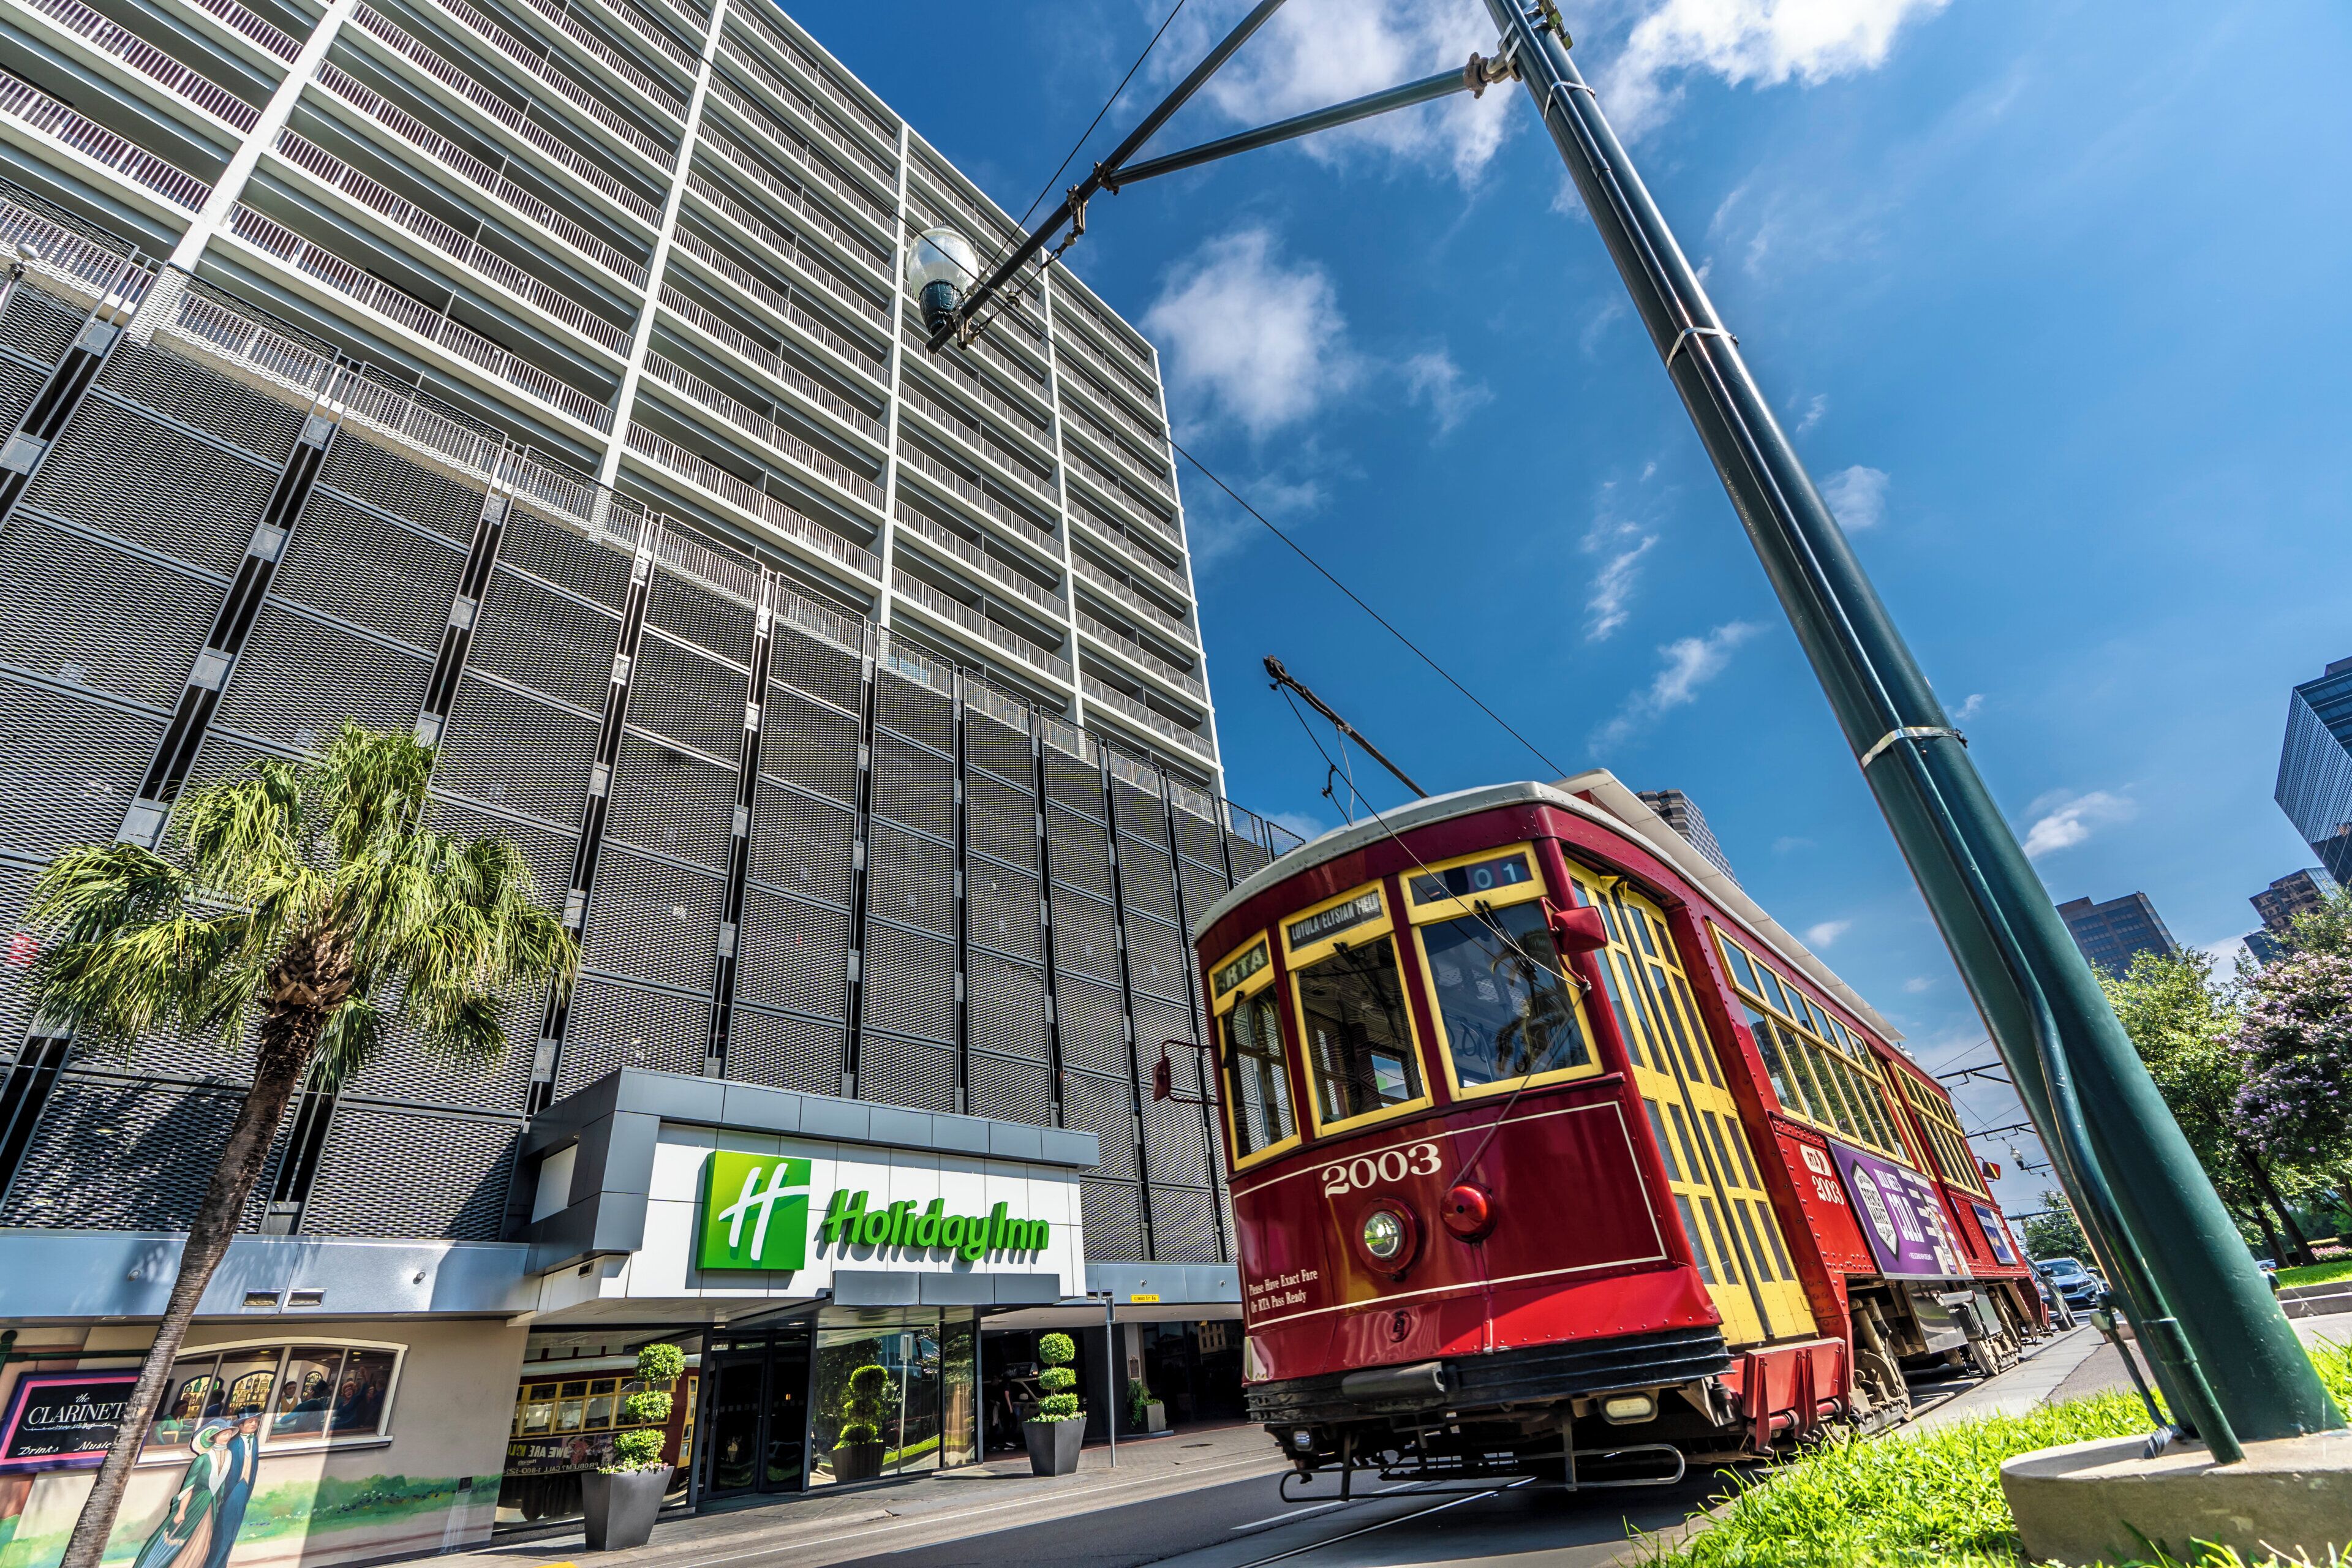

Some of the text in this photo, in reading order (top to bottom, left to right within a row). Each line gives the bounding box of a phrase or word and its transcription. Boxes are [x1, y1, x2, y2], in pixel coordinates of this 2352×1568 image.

[1226, 948, 1264, 989] RTA
[1322, 1143, 1442, 1199] 2003
[1806, 1151, 1820, 1169] RTA
[1811, 1175, 1845, 1205] 2003
[1885, 1192, 1925, 1243] COLD
[1264, 1278, 1280, 1292] Have
[1280, 1273, 1300, 1287] Exact
[1300, 1268, 1319, 1282] Fare
[1250, 1289, 1307, 1313] Or RTA Pass Ready
[75, 1392, 90, 1403] the
[28, 1402, 127, 1425] CLARINET
[17, 1441, 112, 1455] Drinks Music
